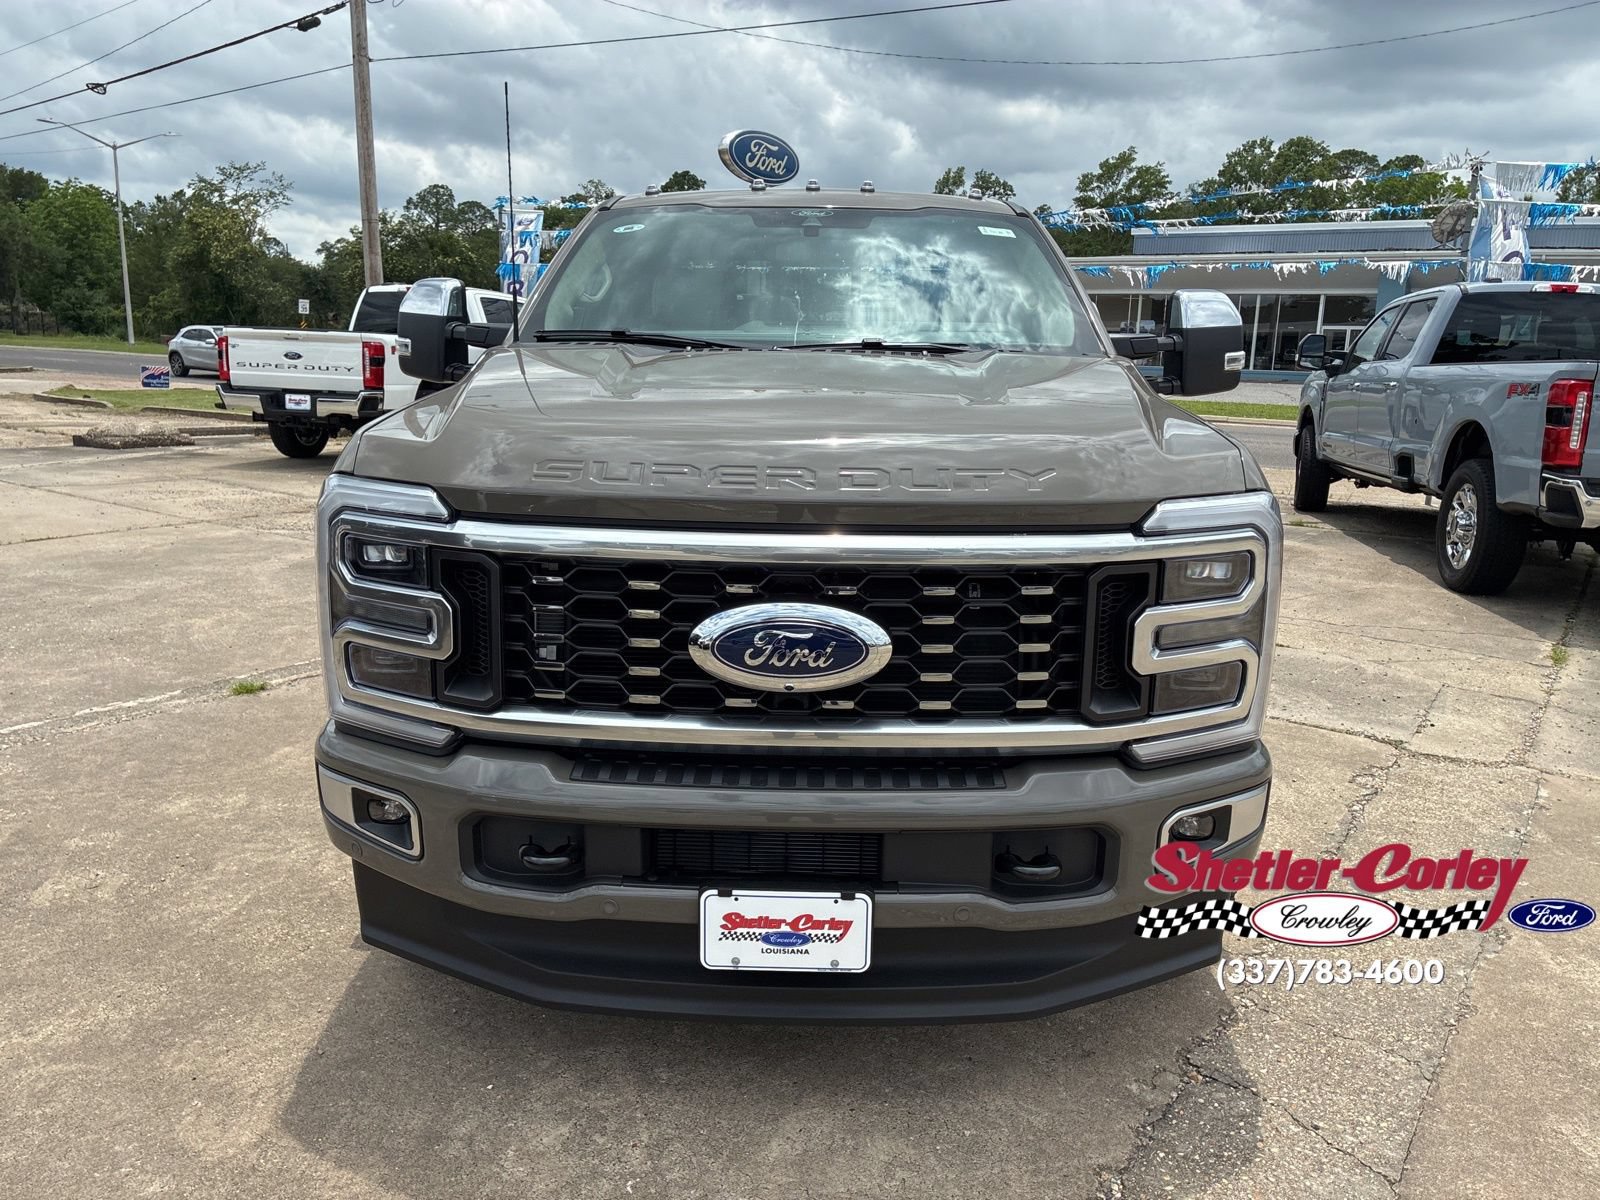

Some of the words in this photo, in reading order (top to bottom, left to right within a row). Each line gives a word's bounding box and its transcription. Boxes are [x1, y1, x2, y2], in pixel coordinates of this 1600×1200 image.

[745, 139, 788, 175] Ford
[236, 361, 298, 370] SUPER
[1506, 383, 1541, 399] FX4
[532, 459, 816, 491] SUPER
[837, 466, 1058, 492] DUTY
[743, 629, 838, 669] Ford
[719, 912, 854, 943] Shetler-Corley
[769, 933, 803, 945] Crowley
[761, 947, 810, 955] LOUISIANA
